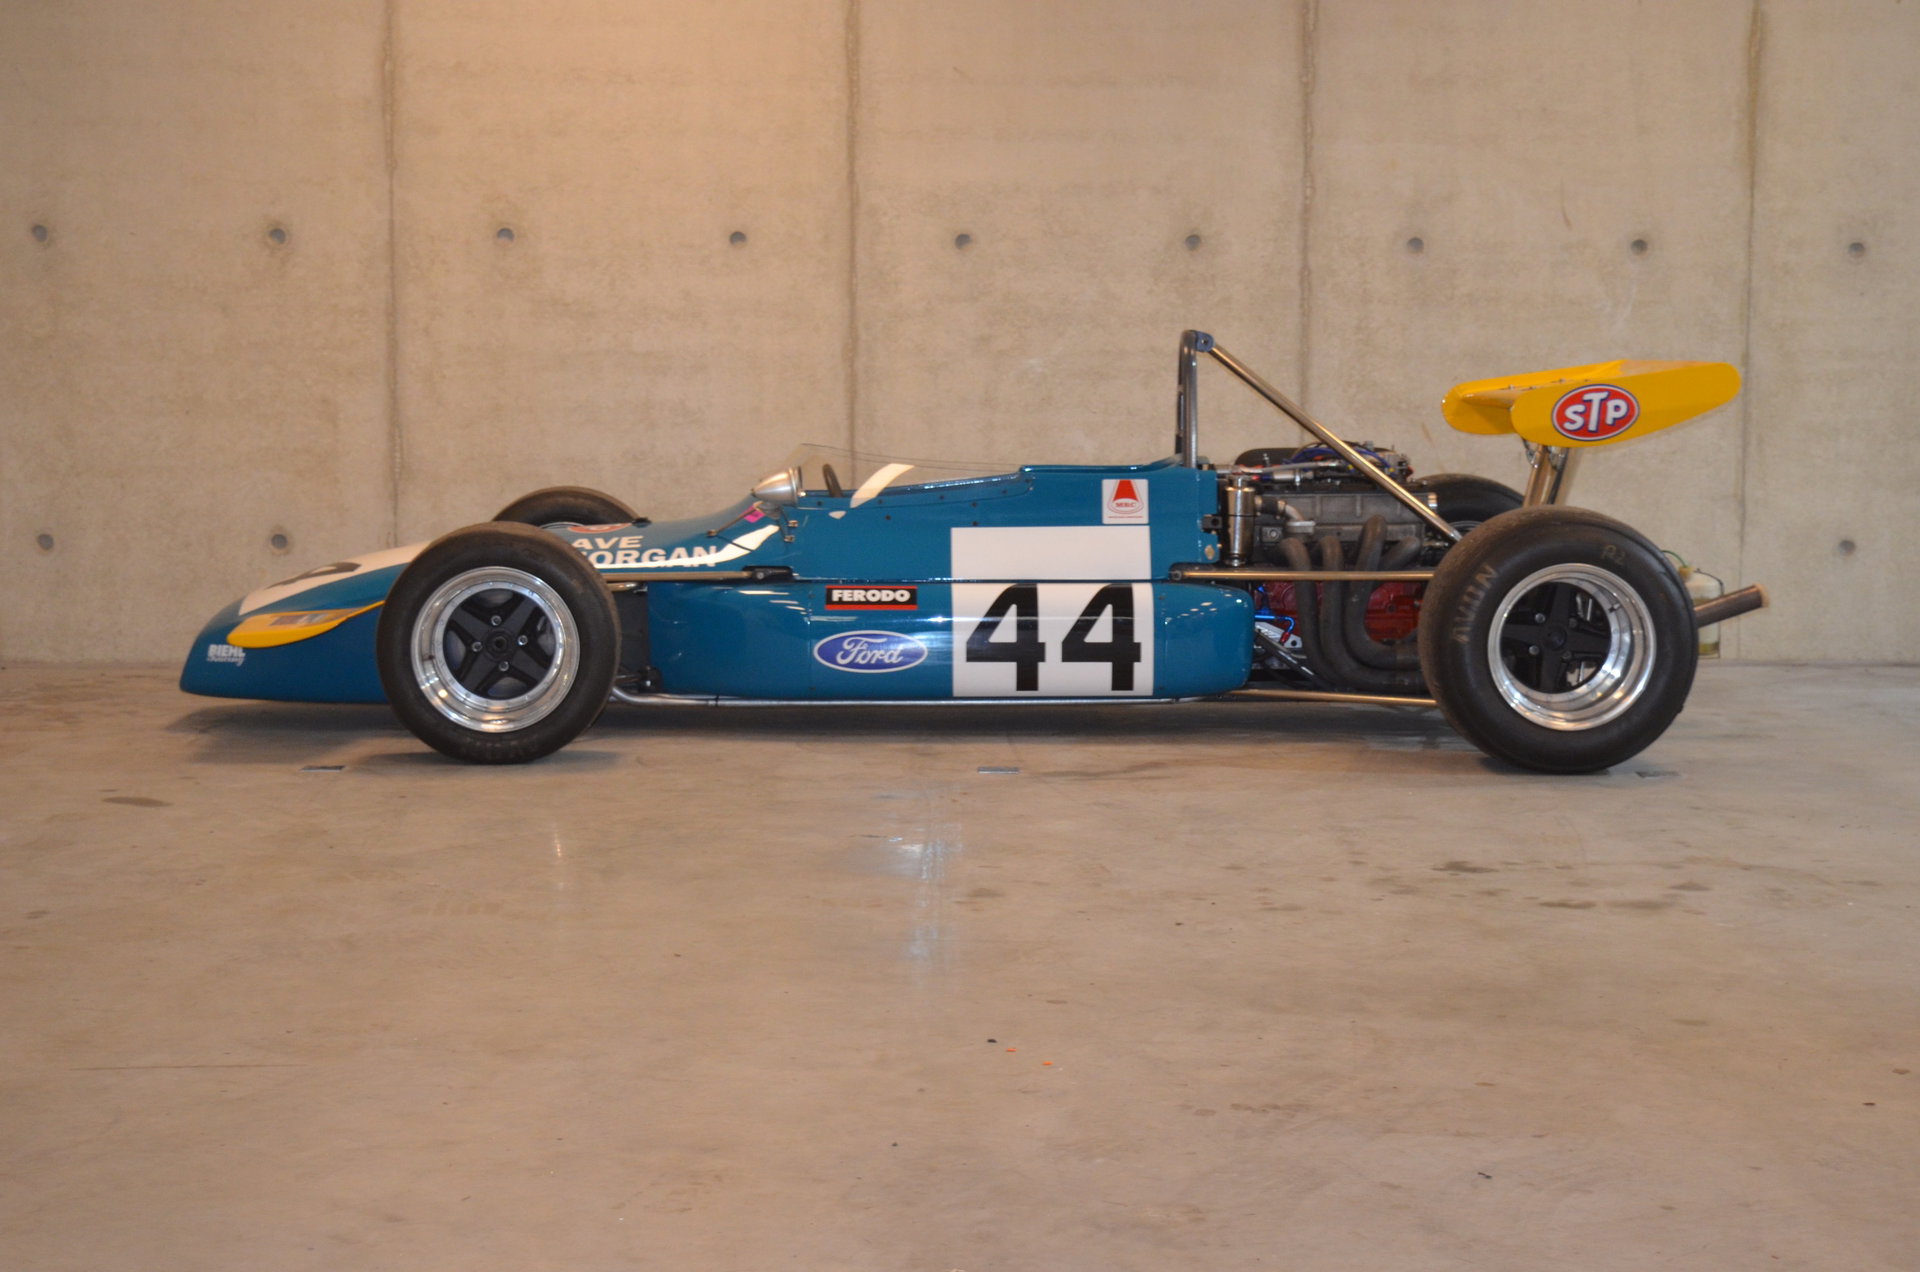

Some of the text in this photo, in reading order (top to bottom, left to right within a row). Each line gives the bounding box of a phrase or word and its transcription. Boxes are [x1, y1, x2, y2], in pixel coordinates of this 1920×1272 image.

[1563, 391, 1628, 431] STP
[571, 535, 644, 549] AVE
[581, 545, 717, 567] ORGAN
[831, 589, 911, 602] FERODO
[966, 583, 1141, 691] 44
[836, 636, 904, 664] Ford
